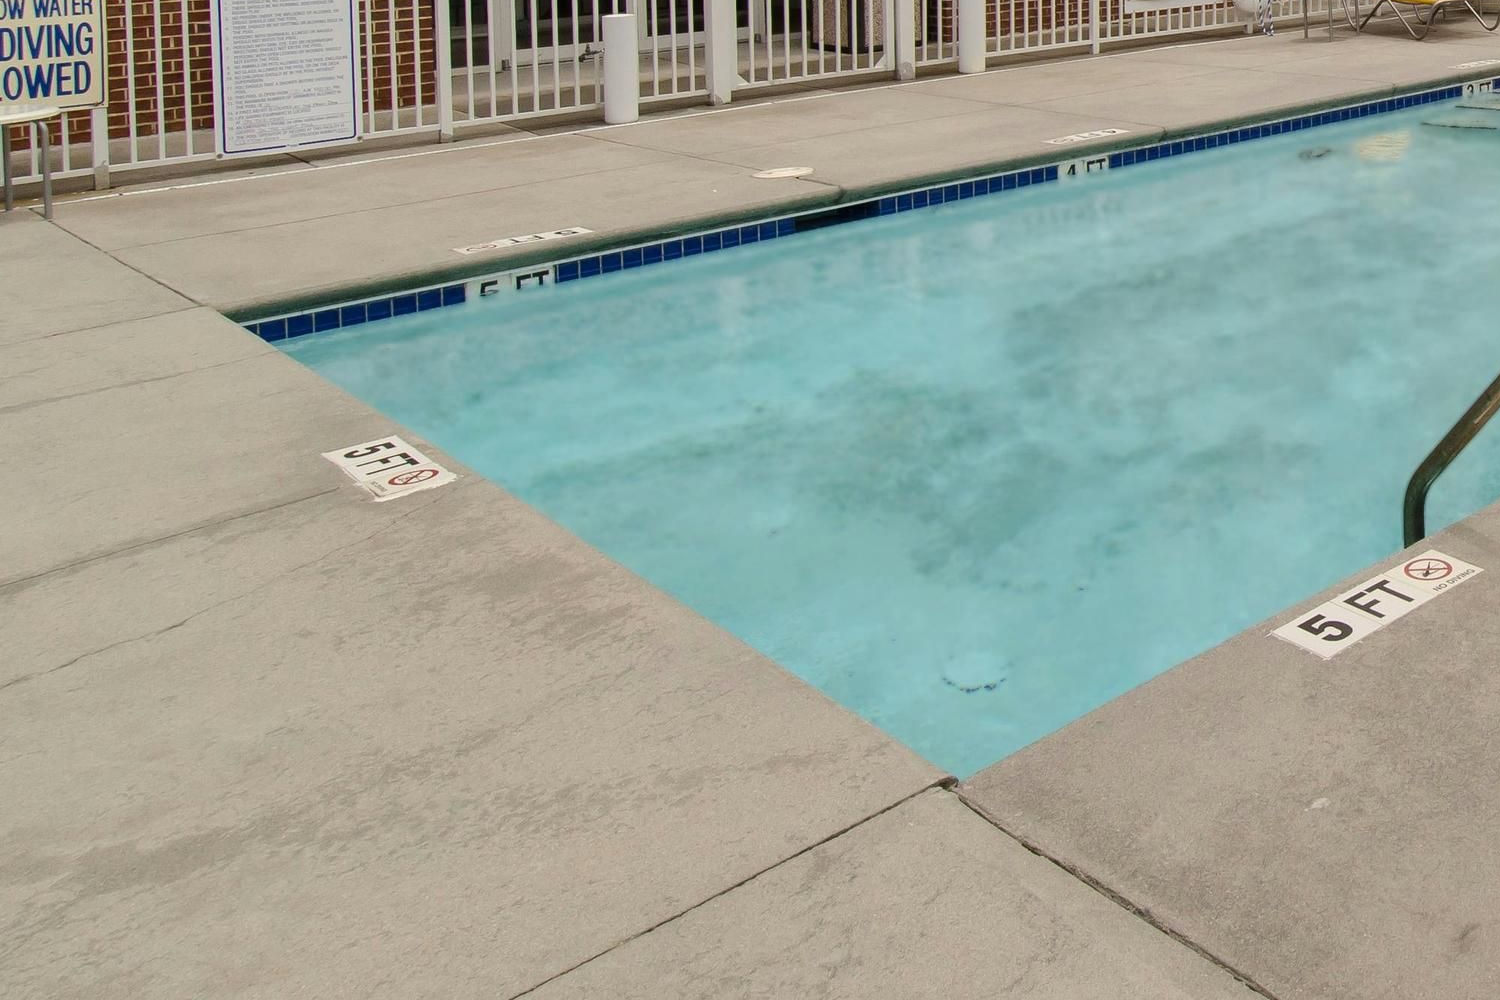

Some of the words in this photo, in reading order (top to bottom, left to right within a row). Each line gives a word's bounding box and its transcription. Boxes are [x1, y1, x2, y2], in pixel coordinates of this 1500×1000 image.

[0, 22, 94, 61] DIVING
[0, 60, 92, 101] OWED
[343, 441, 397, 459] 5
[355, 452, 421, 476] FT
[1432, 583, 1447, 592] NO
[1447, 568, 1477, 586] DIVING
[1297, 614, 1354, 642] 5
[1343, 579, 1416, 619] FT
